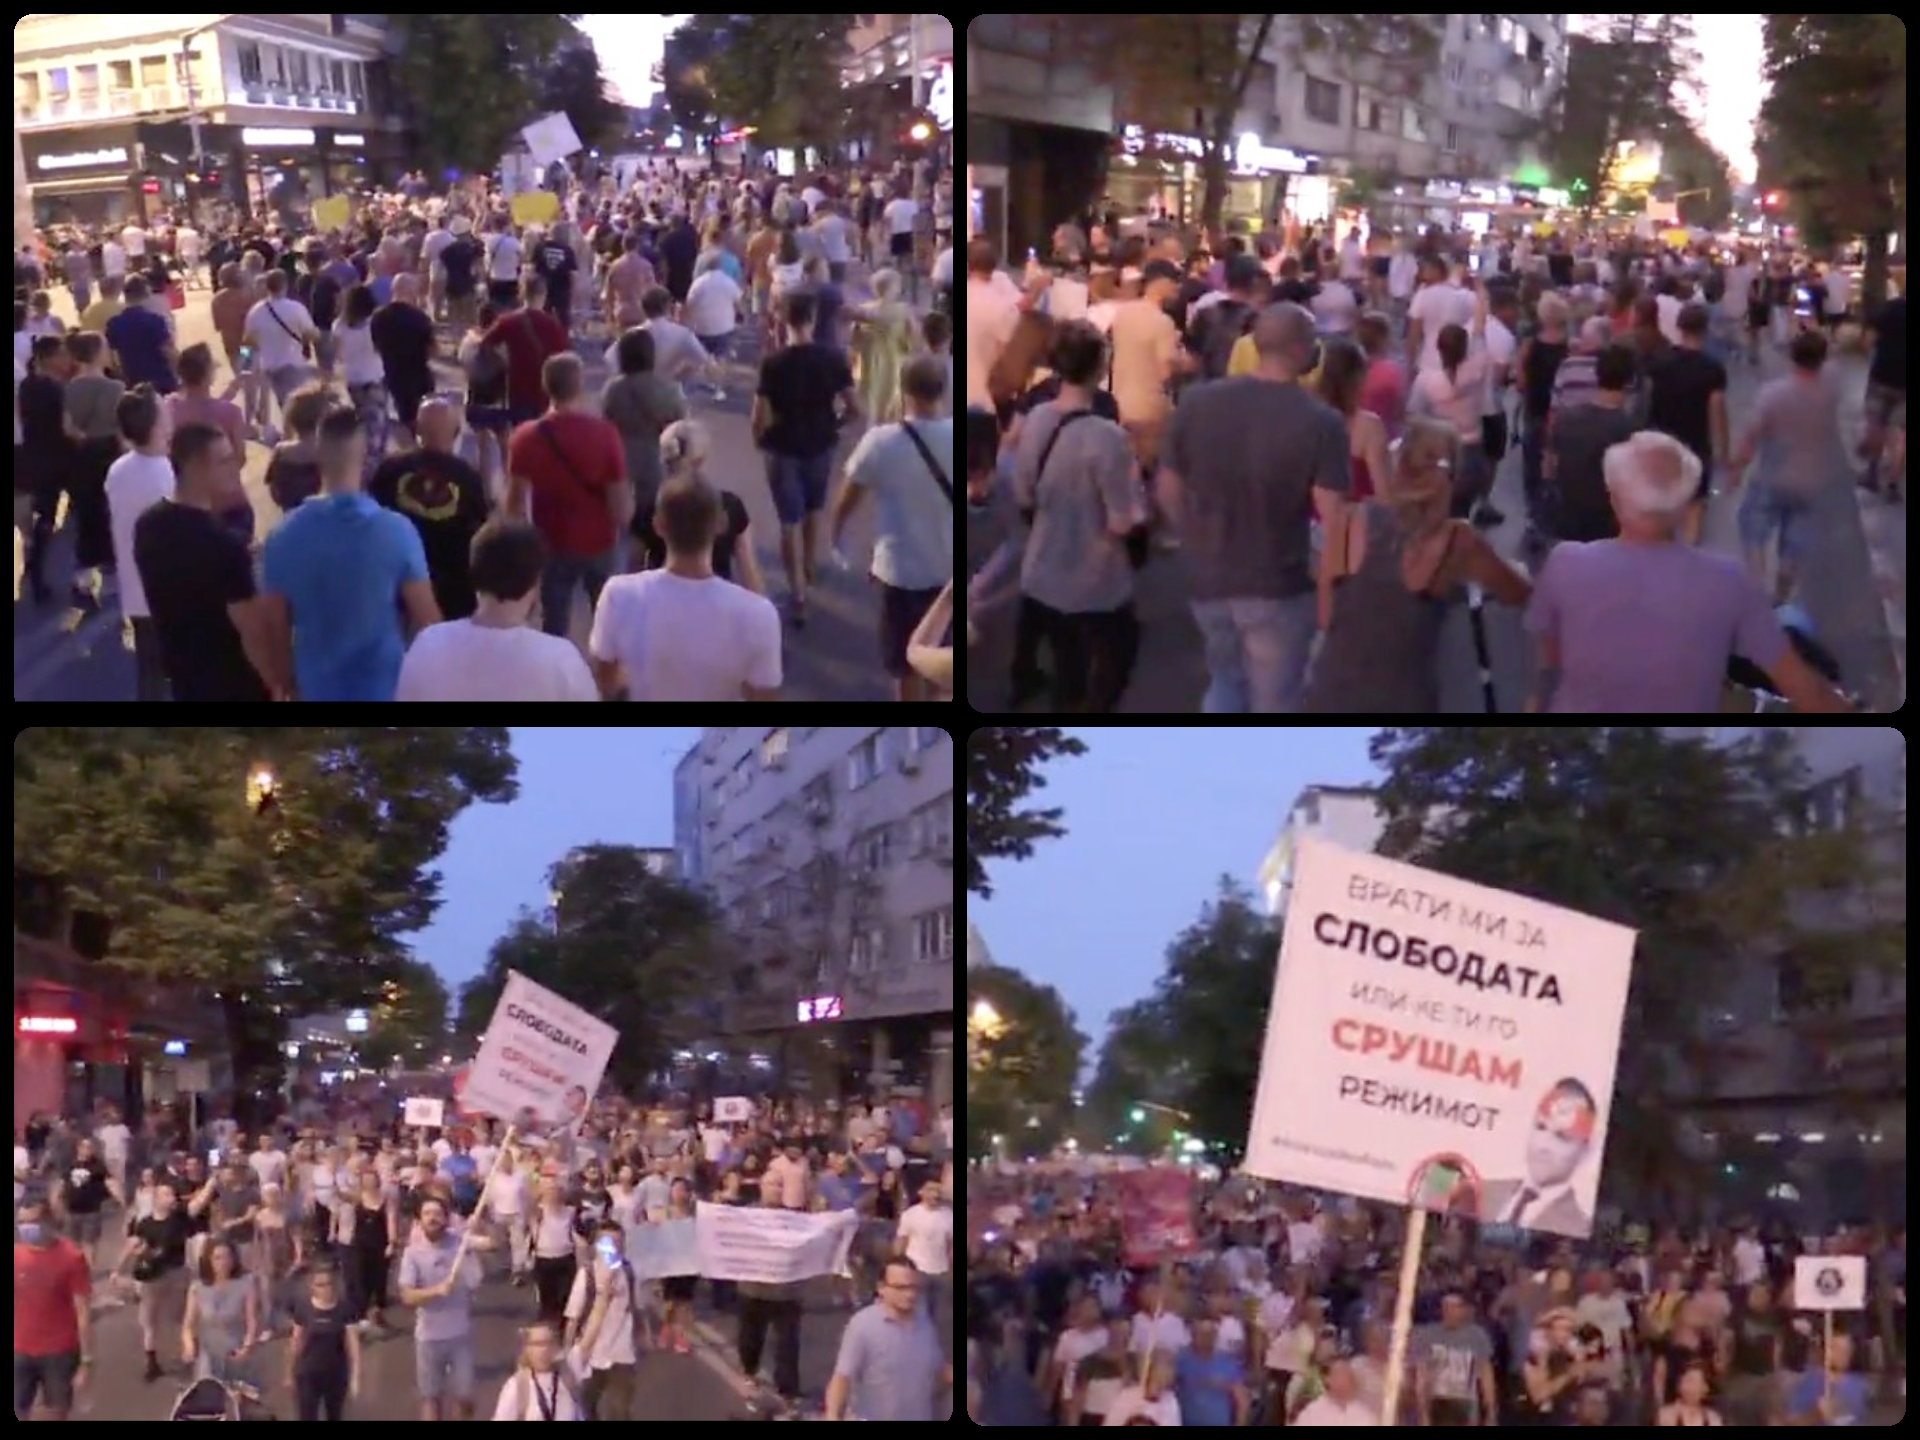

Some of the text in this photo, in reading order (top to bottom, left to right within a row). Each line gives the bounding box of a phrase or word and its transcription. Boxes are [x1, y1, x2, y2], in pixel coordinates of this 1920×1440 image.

[1347, 874, 1451, 920] ВРАТИ
[1458, 905, 1507, 939] МИ
[1313, 912, 1562, 1005] СЛОБОДАТА
[506, 1003, 588, 1055] СЛОБОДАТА
[1331, 1018, 1522, 1089] СРУШАМ
[1488, 1013, 1518, 1040] ГО
[1339, 1074, 1500, 1131] РЕЖИМОТ
